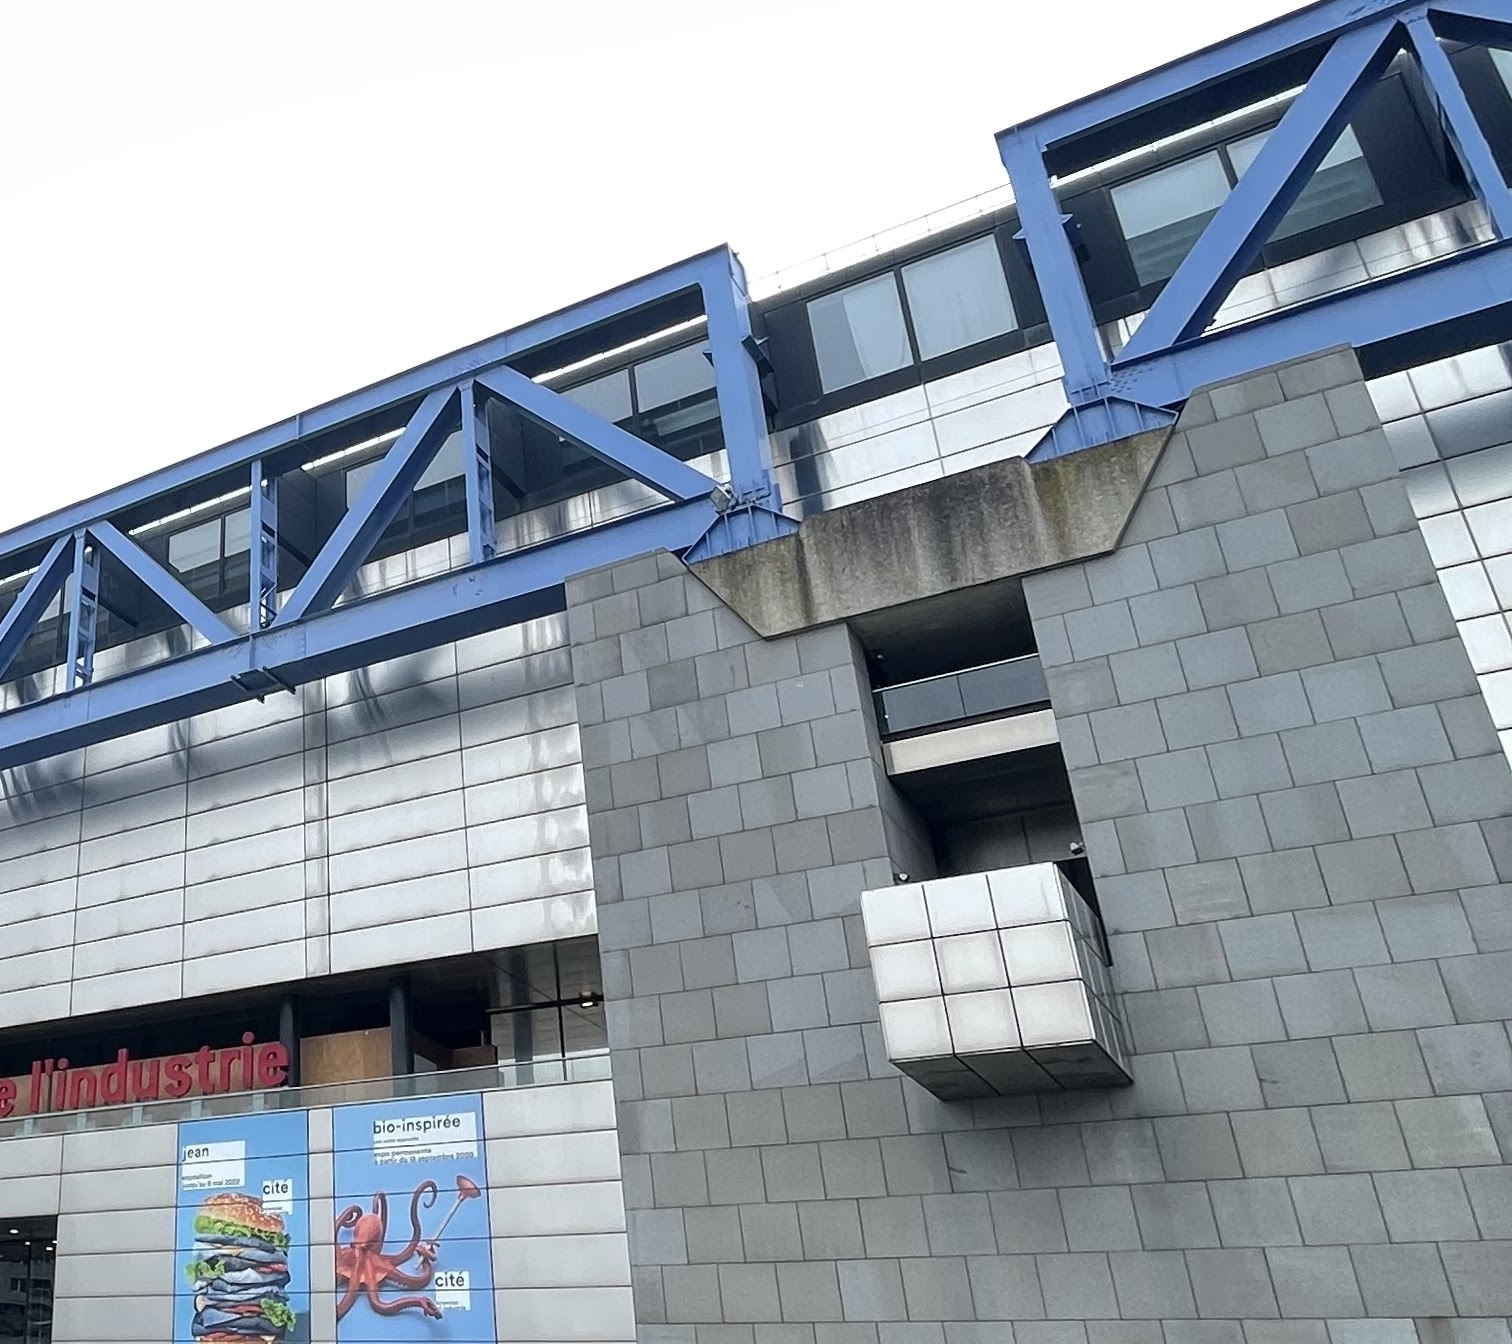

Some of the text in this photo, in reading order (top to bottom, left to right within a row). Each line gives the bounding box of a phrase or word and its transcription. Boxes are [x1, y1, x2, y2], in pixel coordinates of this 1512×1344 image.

[30, 1031, 289, 1113] l'industrie
[373, 1114, 461, 1134] bio-inspirée
[182, 1145, 209, 1162] jean
[263, 1178, 288, 1194] cité
[435, 1270, 465, 1287] cité
